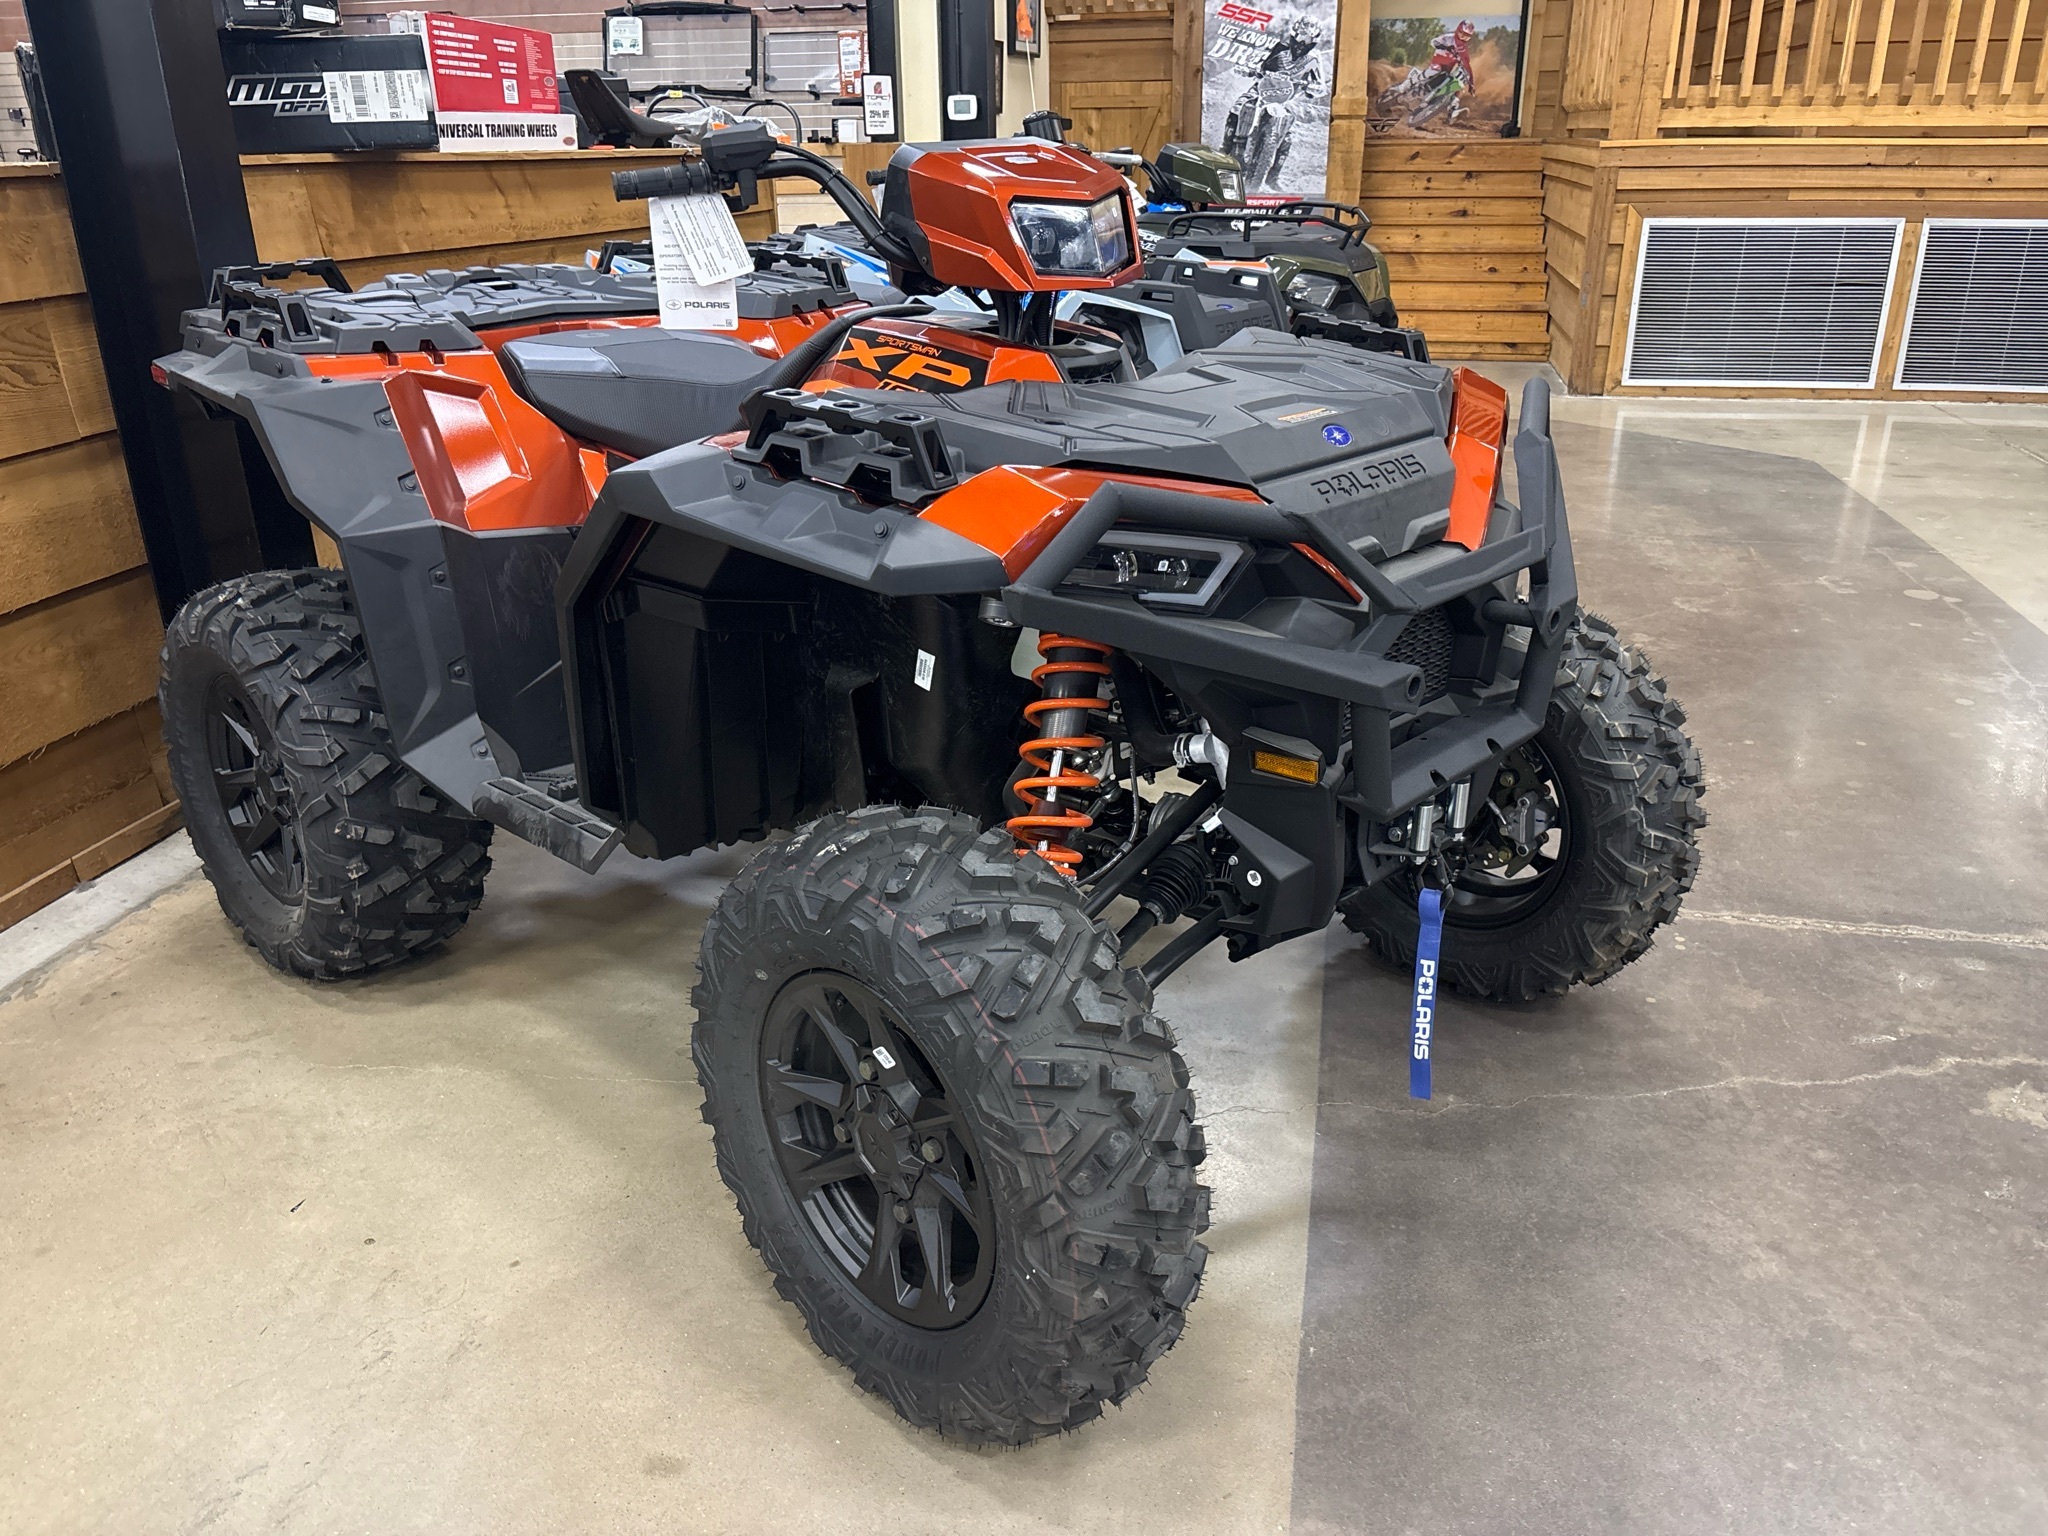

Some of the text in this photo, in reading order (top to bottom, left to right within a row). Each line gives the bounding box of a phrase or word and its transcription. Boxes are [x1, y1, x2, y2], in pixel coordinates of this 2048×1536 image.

[1217, 2, 1274, 32] SSR
[1218, 23, 1280, 50] WE KNOW
[438, 123, 558, 138] NIVERSAL TRAINING WHEELS
[684, 301, 731, 309] POLARIS
[876, 335, 942, 357] SPORTSMAN
[828, 337, 972, 388] XP
[1310, 453, 1427, 504] POLARIS
[1413, 959, 1436, 1060] POLARIS
